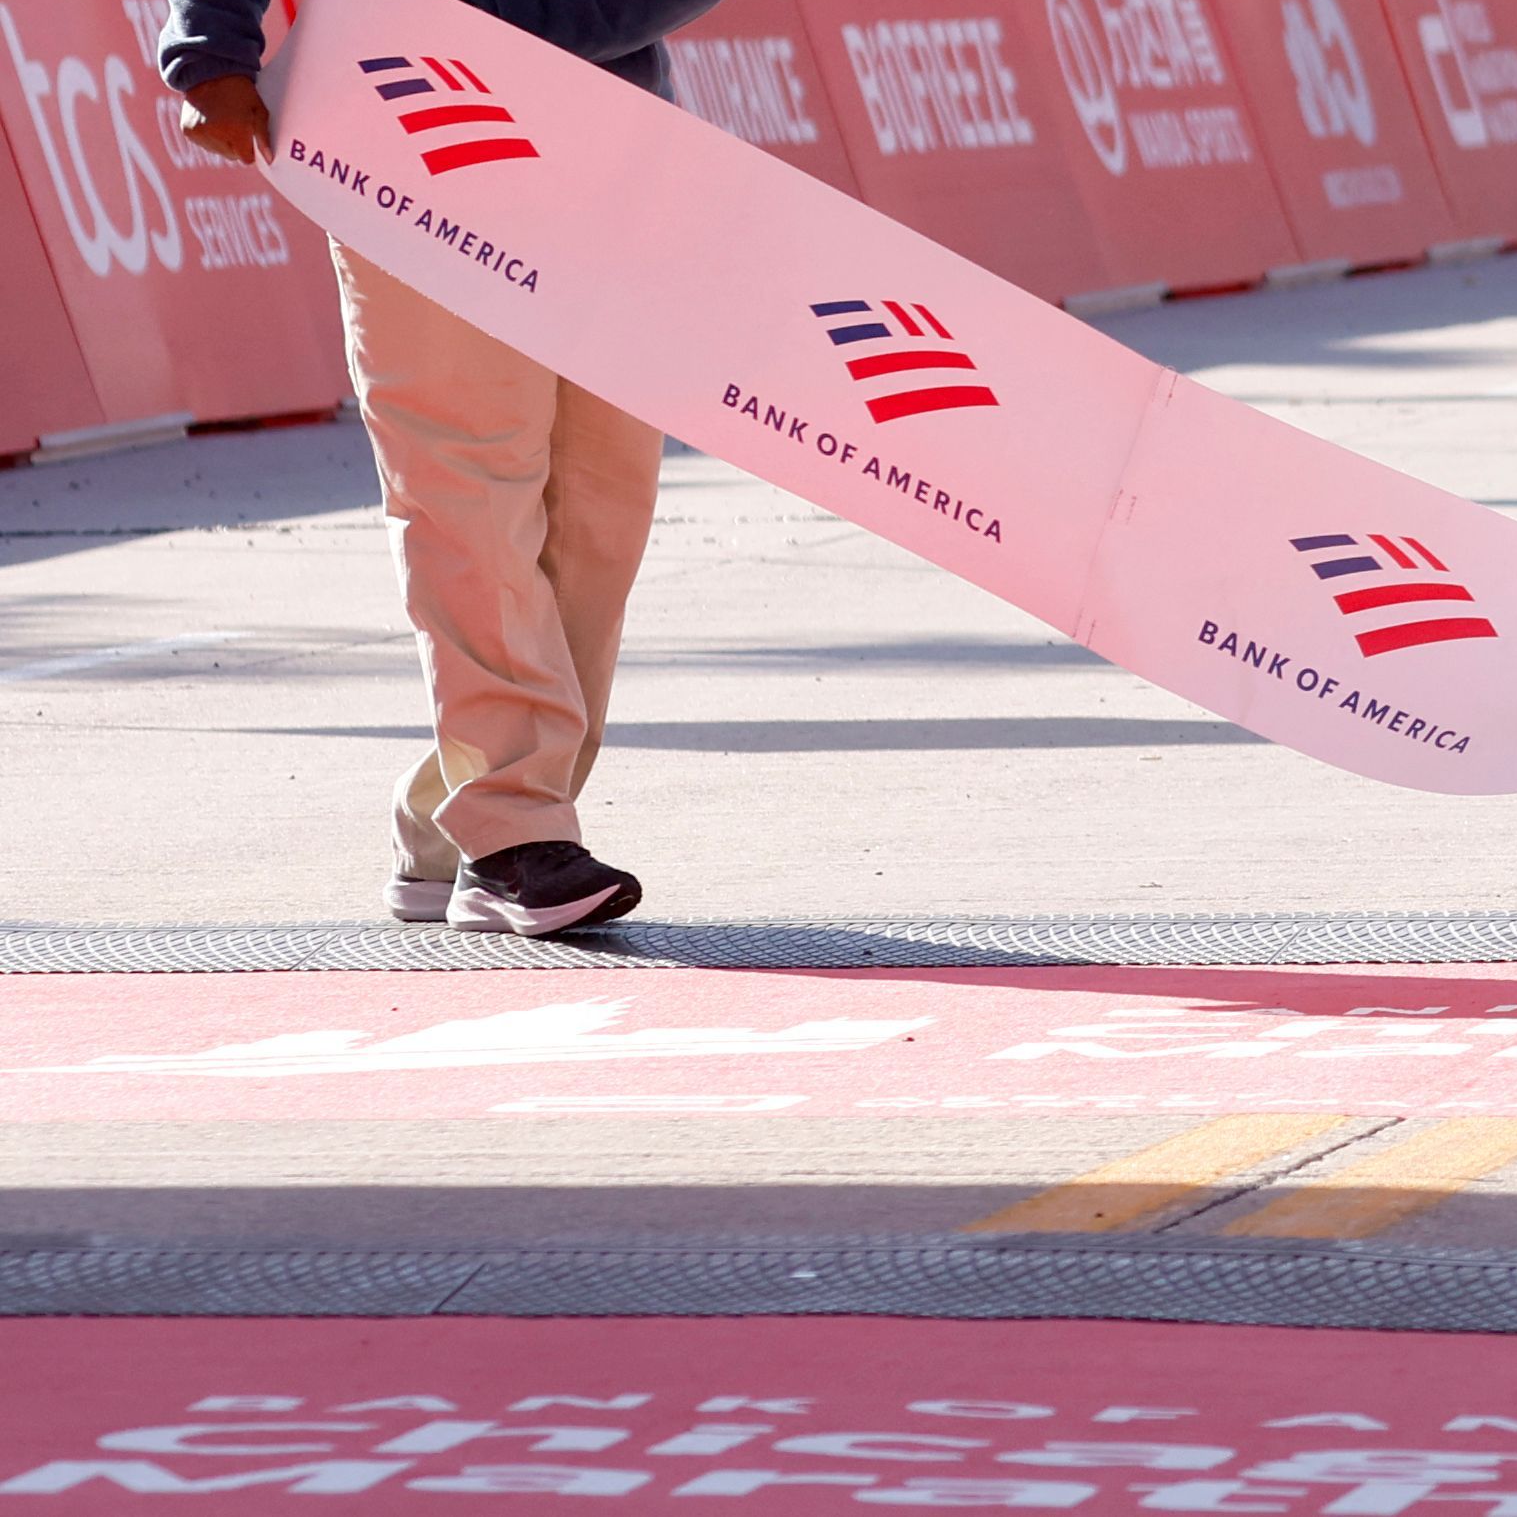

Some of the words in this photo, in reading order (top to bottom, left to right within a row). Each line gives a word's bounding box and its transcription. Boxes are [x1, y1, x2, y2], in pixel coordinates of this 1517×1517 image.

[840, 16, 1036, 157] BIOFREEZE
[185, 194, 290, 270] SERVICES
[289, 138, 371, 197] BANK
[375, 184, 415, 217] OF
[414, 208, 542, 294] AMERICA
[721, 382, 810, 444] BANK
[815, 432, 859, 464] OF
[861, 456, 1003, 544] AMERICA
[1197, 619, 1290, 680] BANK
[1295, 666, 1342, 701] OF
[1338, 689, 1474, 755] AMERICA
[186, 1392, 816, 1414] BANK
[904, 1397, 1197, 1424] OF
